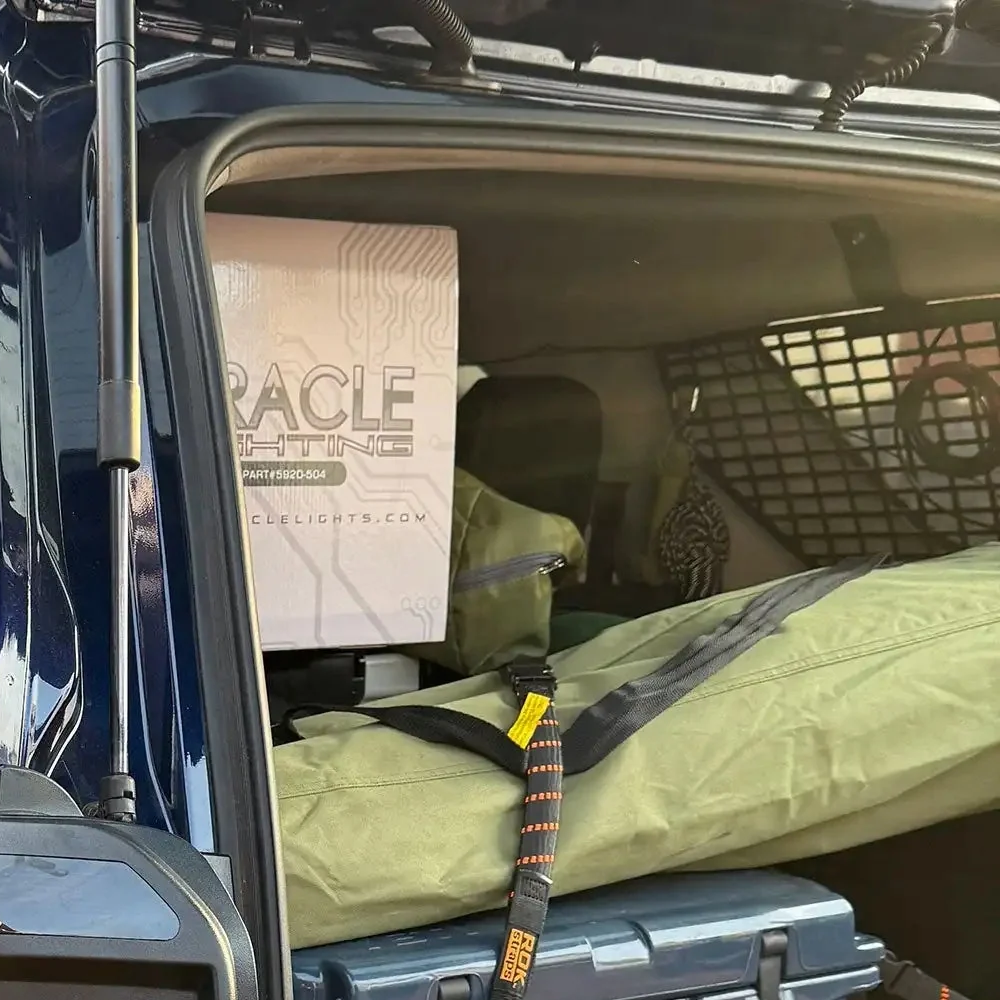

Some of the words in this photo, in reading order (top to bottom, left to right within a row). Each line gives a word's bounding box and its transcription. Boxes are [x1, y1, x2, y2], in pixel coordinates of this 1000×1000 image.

[226, 362, 415, 432] RACLE
[238, 433, 414, 458] HTING
[503, 930, 521, 979] straps
[513, 932, 536, 986] ROK
